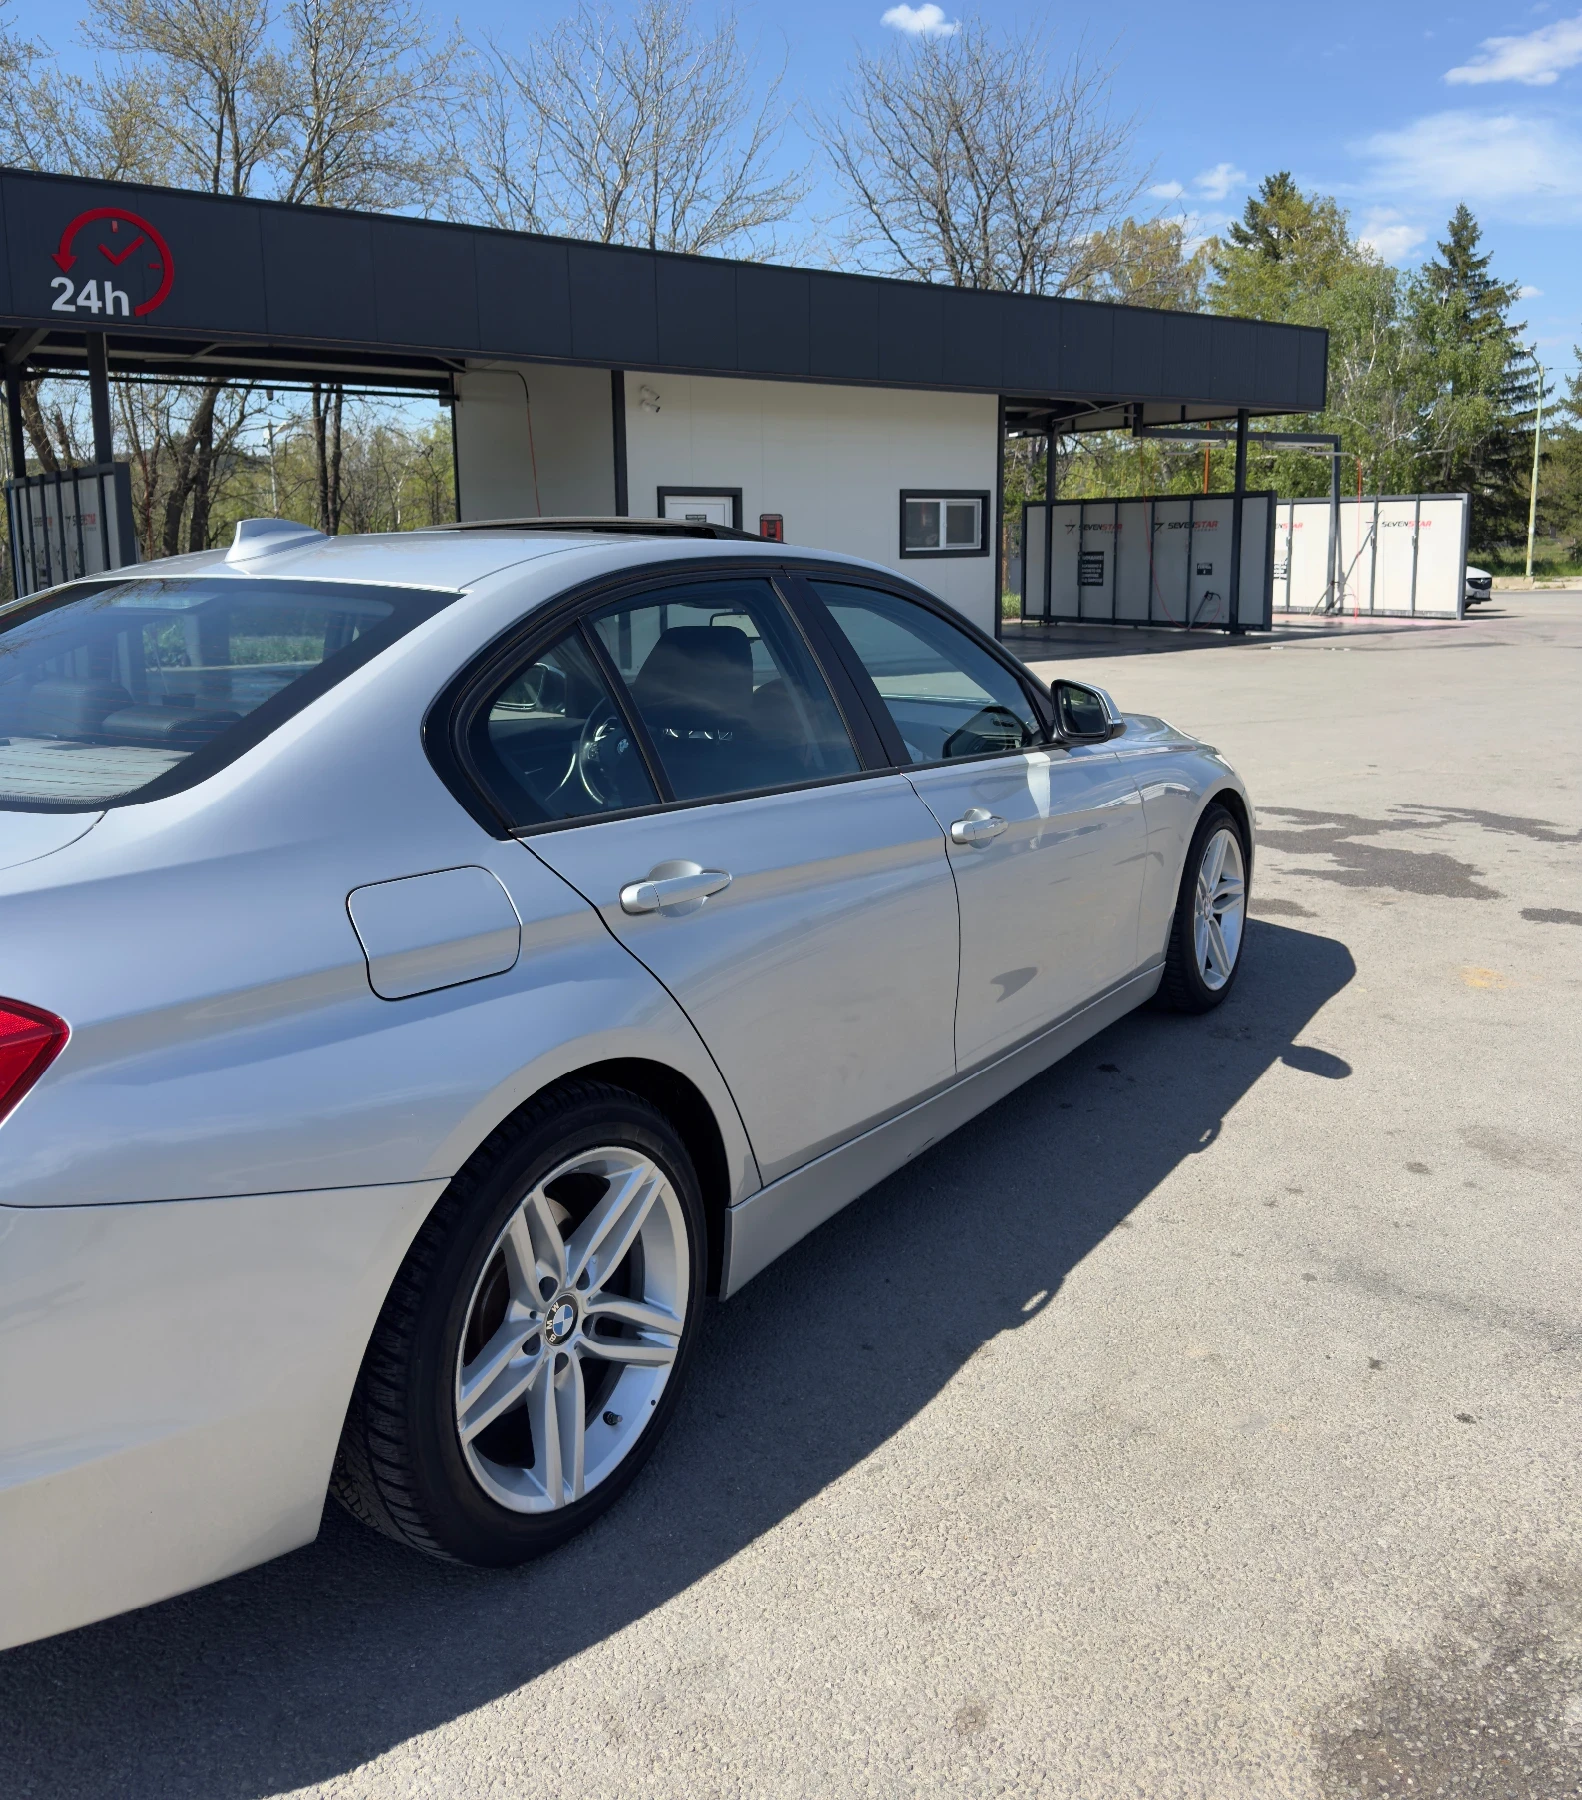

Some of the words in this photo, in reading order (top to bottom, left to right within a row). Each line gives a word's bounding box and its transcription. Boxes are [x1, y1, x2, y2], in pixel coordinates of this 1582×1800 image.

[50, 276, 130, 317] 24h
[1381, 520, 1432, 528] SEVENSAR
[546, 1302, 560, 1342] BMW
